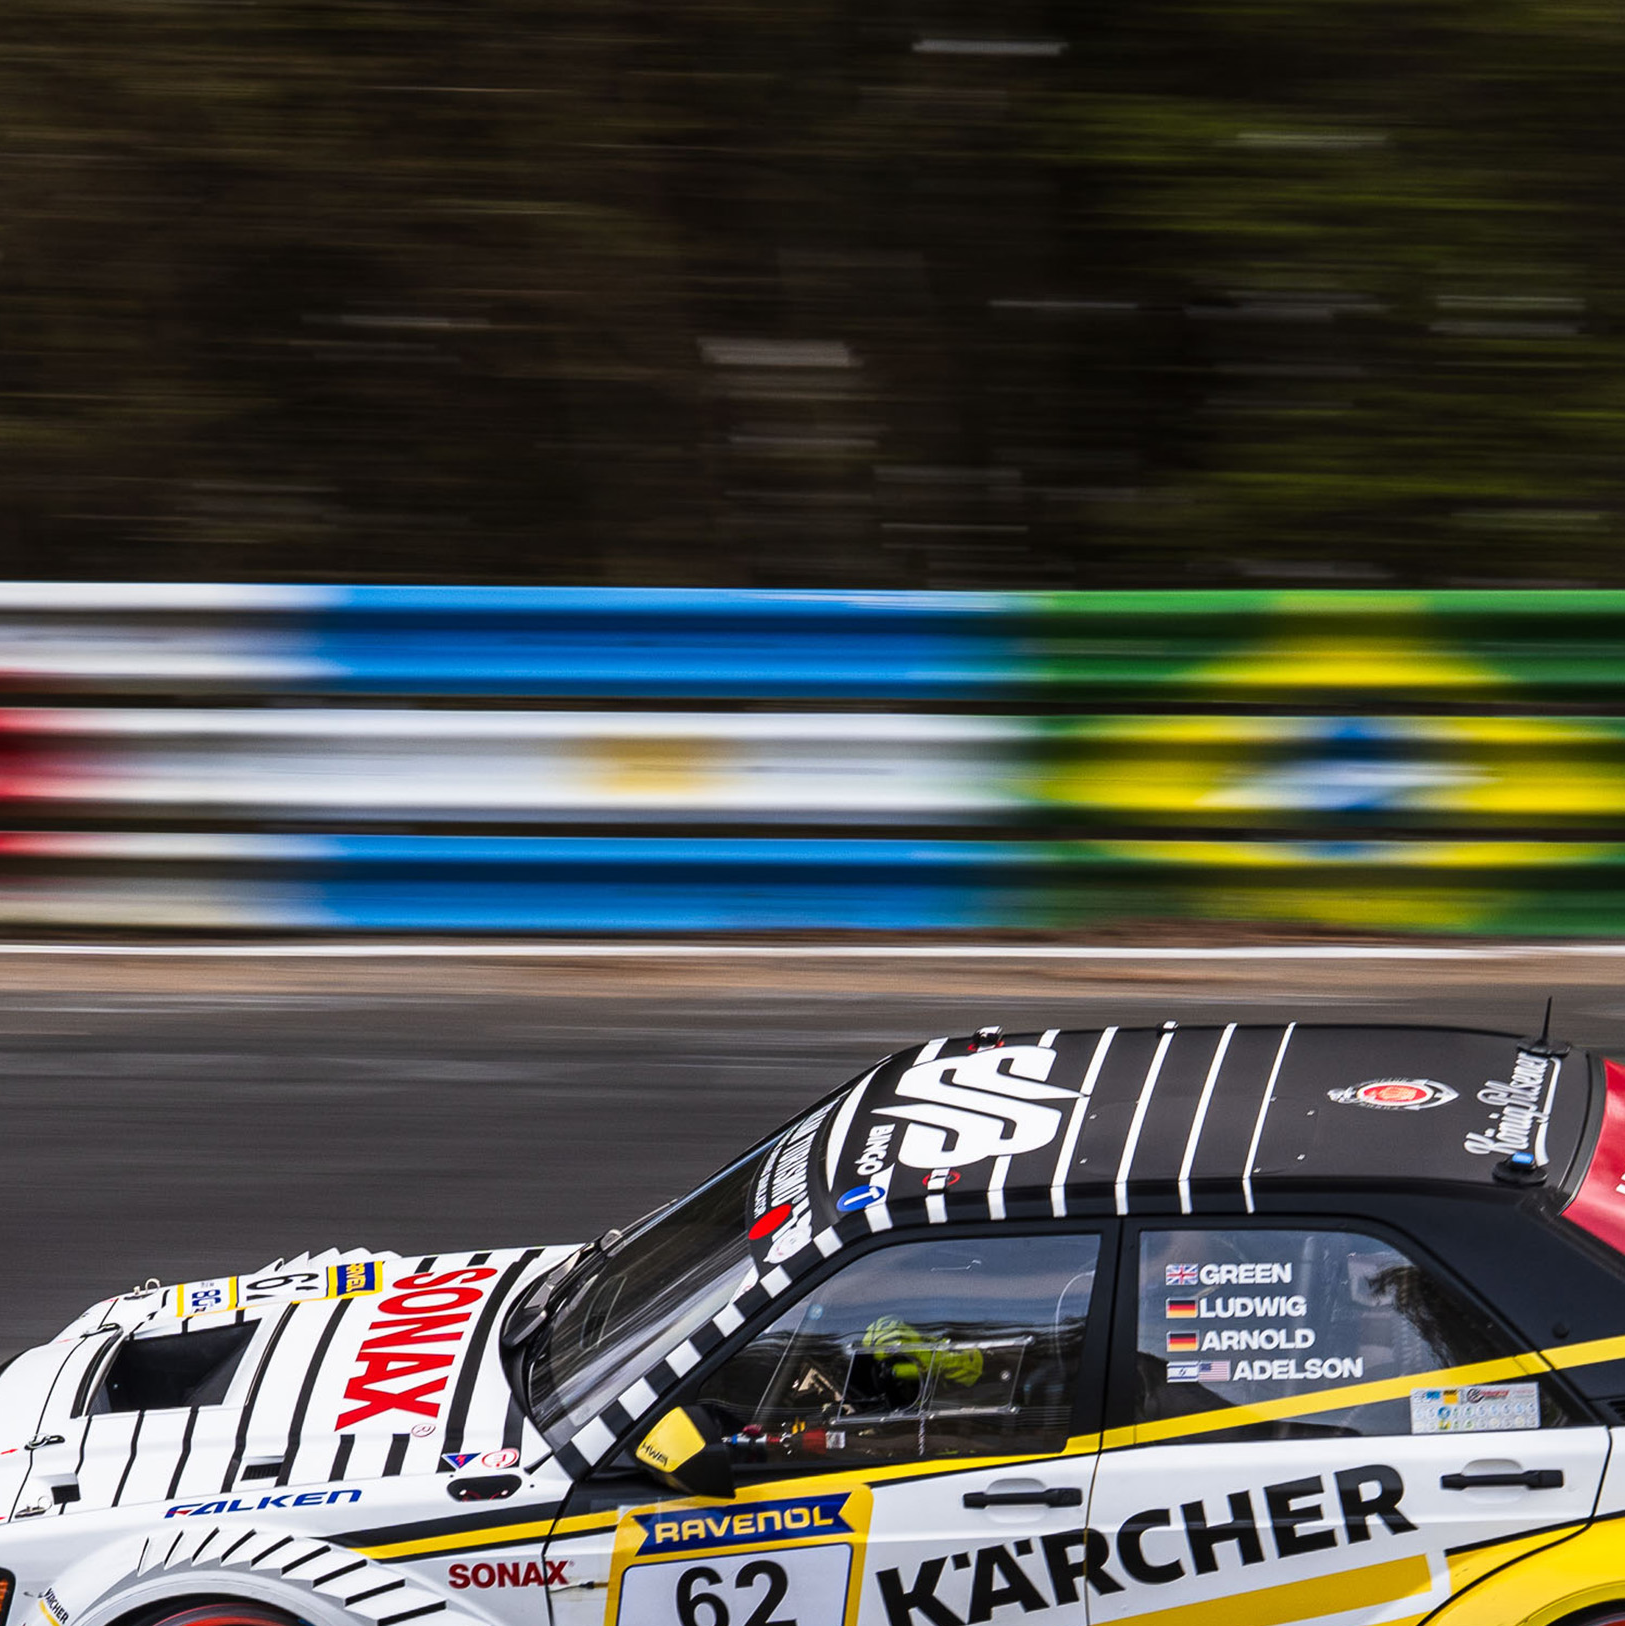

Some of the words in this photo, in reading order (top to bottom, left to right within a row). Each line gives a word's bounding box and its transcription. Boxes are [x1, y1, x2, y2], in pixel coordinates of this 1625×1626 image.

[854, 1123, 896, 1175] BINGO
[771, 1131, 817, 1207] TURISMO
[1199, 1262, 1293, 1286] GREEN
[1199, 1295, 1307, 1319] LUDWIG
[334, 1268, 498, 1432] SONAX
[1200, 1328, 1316, 1352] ARNOLD
[1232, 1356, 1364, 1382] ADELSON
[163, 1489, 363, 1519] FALKEN
[654, 1505, 835, 1545] RAVENOL
[448, 1559, 571, 1590] SONAX
